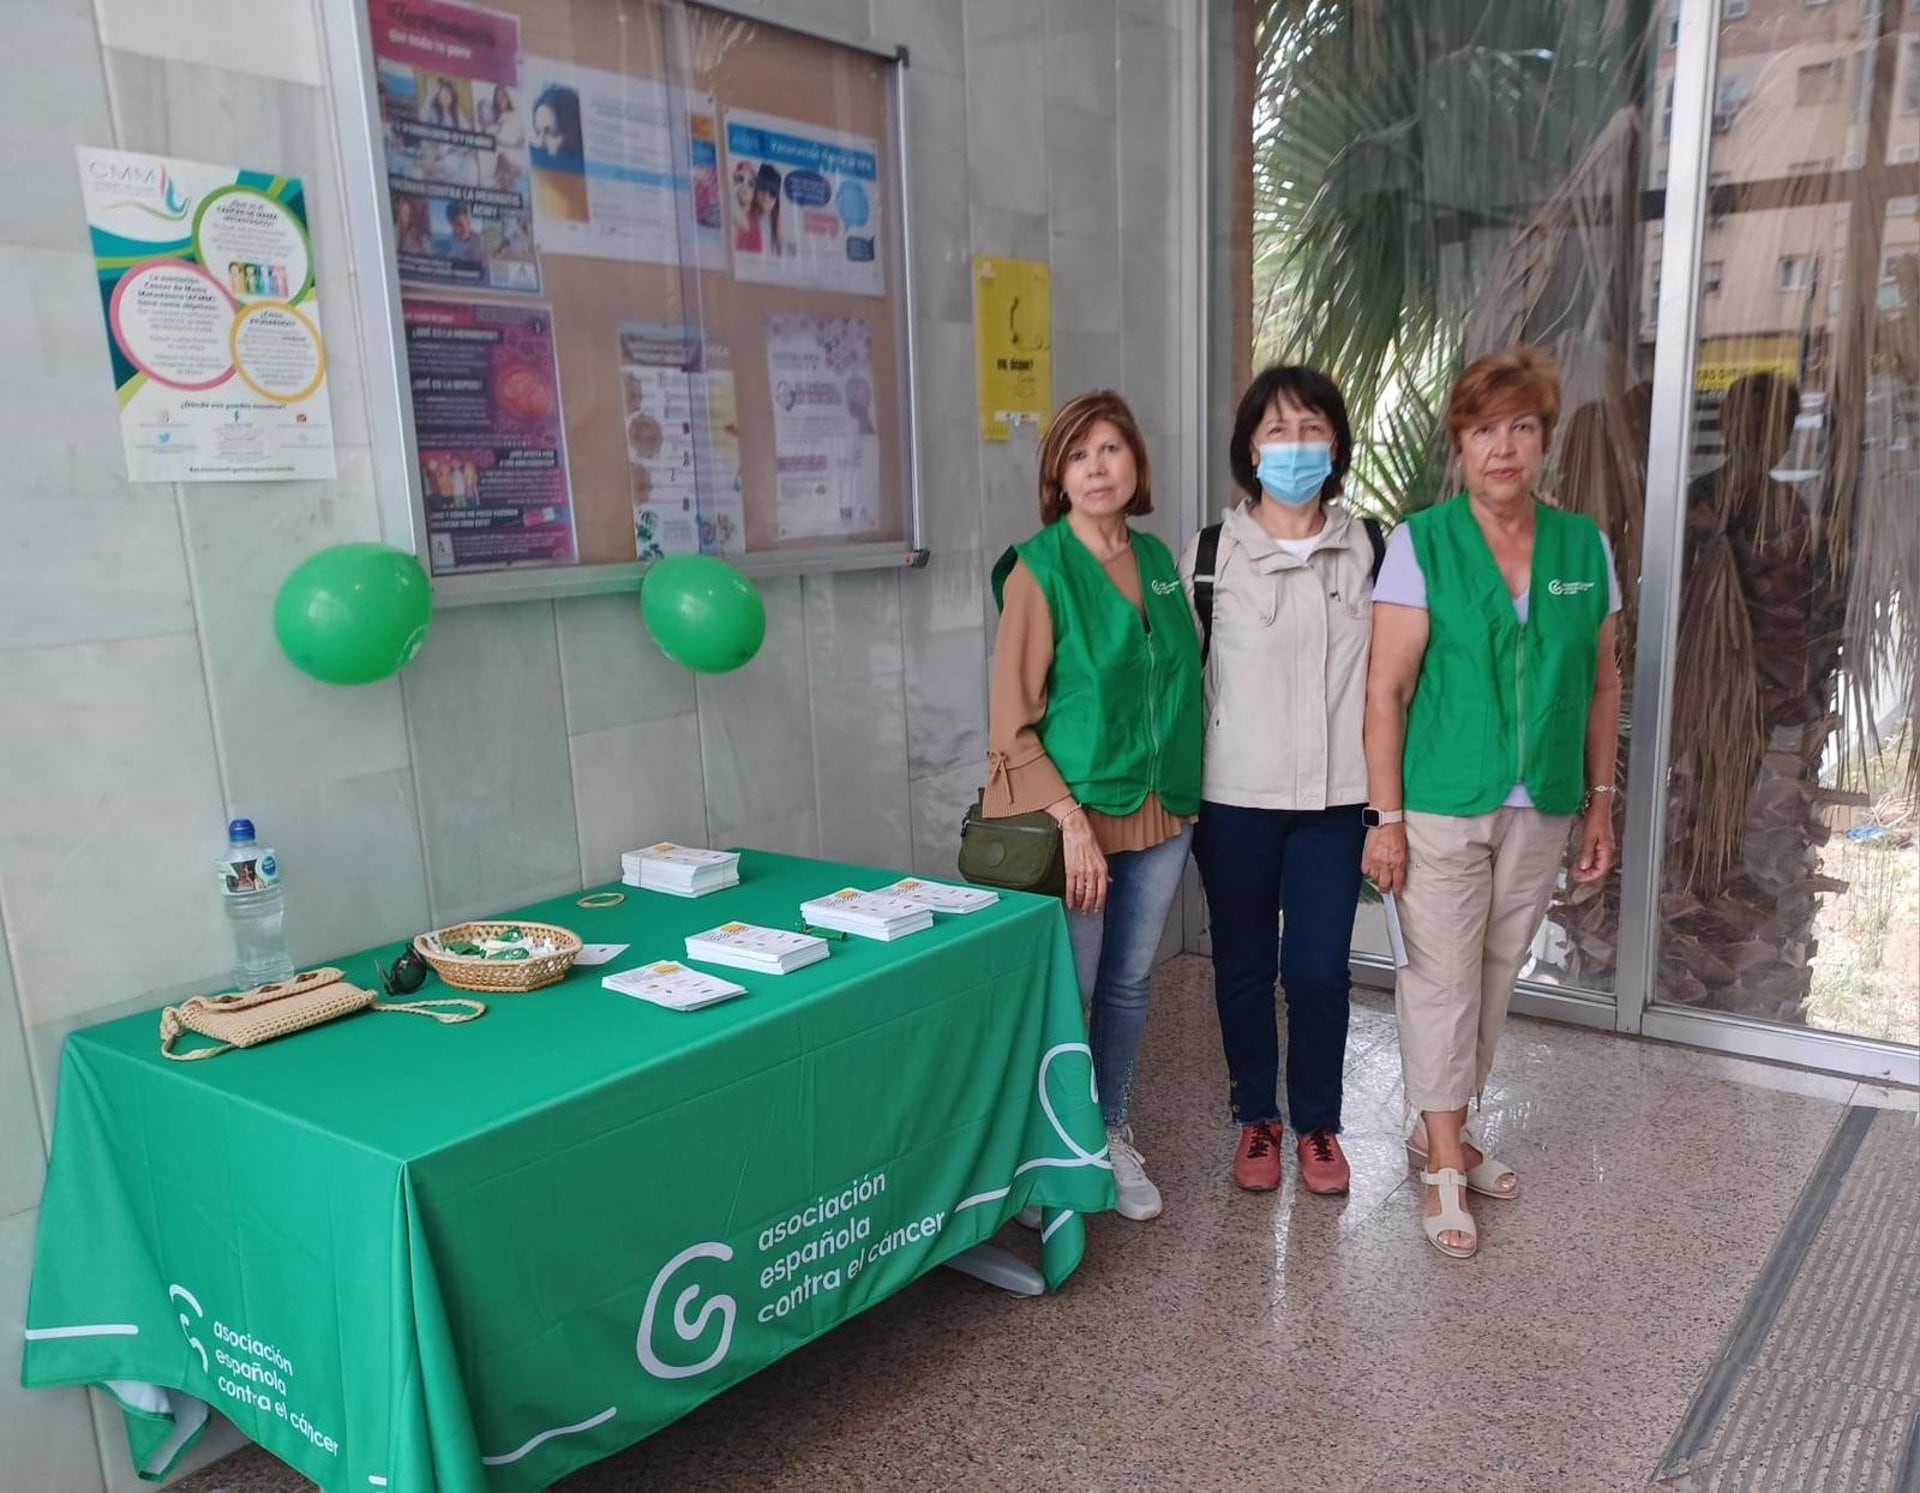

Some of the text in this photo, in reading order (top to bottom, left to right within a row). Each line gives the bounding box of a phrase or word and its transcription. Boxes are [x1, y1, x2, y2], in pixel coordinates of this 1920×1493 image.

[757, 1171, 887, 1252] asociación
[757, 1210, 945, 1323] contra el cáncer
[759, 1216, 871, 1290] española
[213, 1321, 294, 1376] asociación
[215, 1349, 287, 1396] española
[218, 1375, 338, 1456] contra el cáncer
